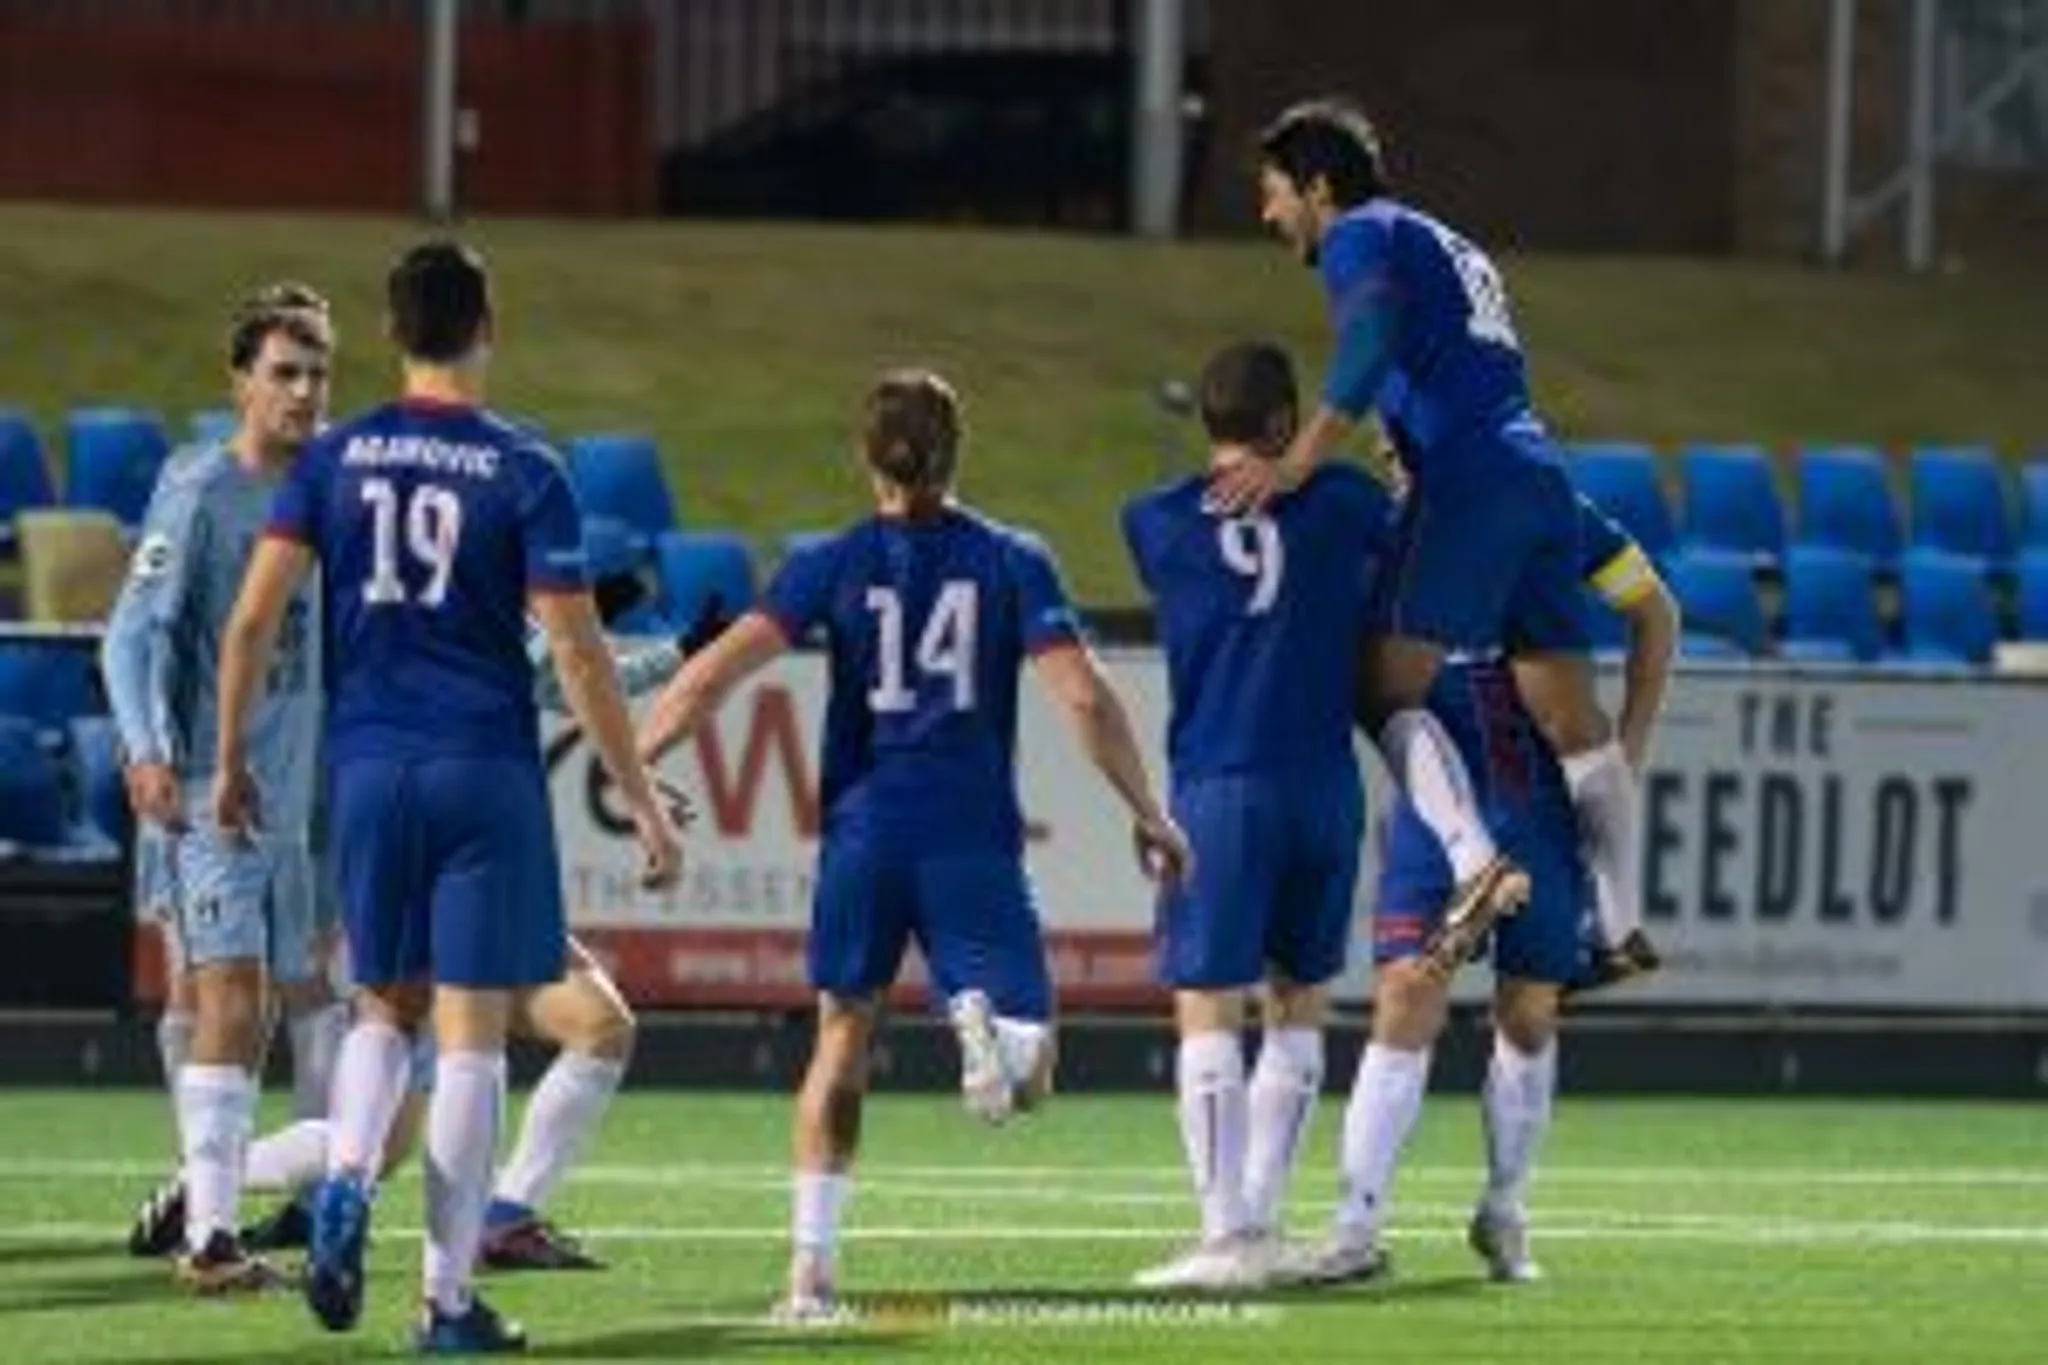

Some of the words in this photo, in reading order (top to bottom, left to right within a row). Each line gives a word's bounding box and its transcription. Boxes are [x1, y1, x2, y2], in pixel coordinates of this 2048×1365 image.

[360, 478, 461, 607] 19
[1220, 514, 1284, 616] 9
[866, 578, 978, 713] 14
[1737, 690, 1834, 757] THE
[1643, 770, 1972, 925] EEDLOT
